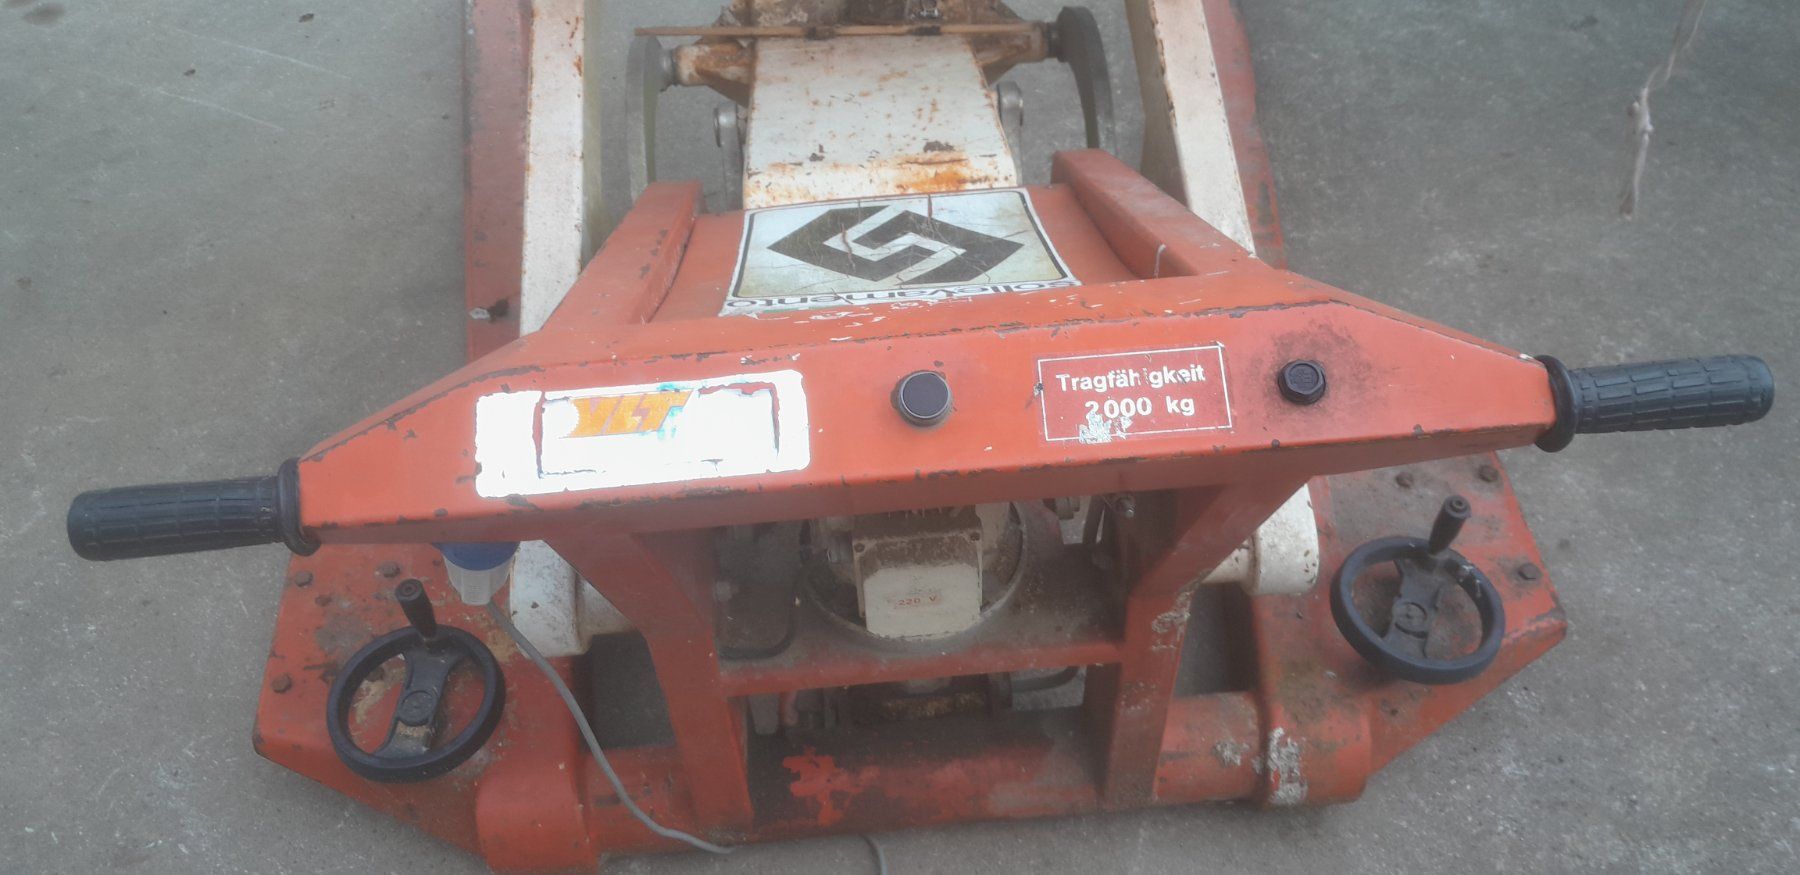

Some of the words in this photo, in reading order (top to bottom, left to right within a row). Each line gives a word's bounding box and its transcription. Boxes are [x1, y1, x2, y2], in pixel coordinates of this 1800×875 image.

[1085, 397, 1152, 420] 2000
[1166, 395, 1195, 416] kg
[897, 597, 921, 606] 220
